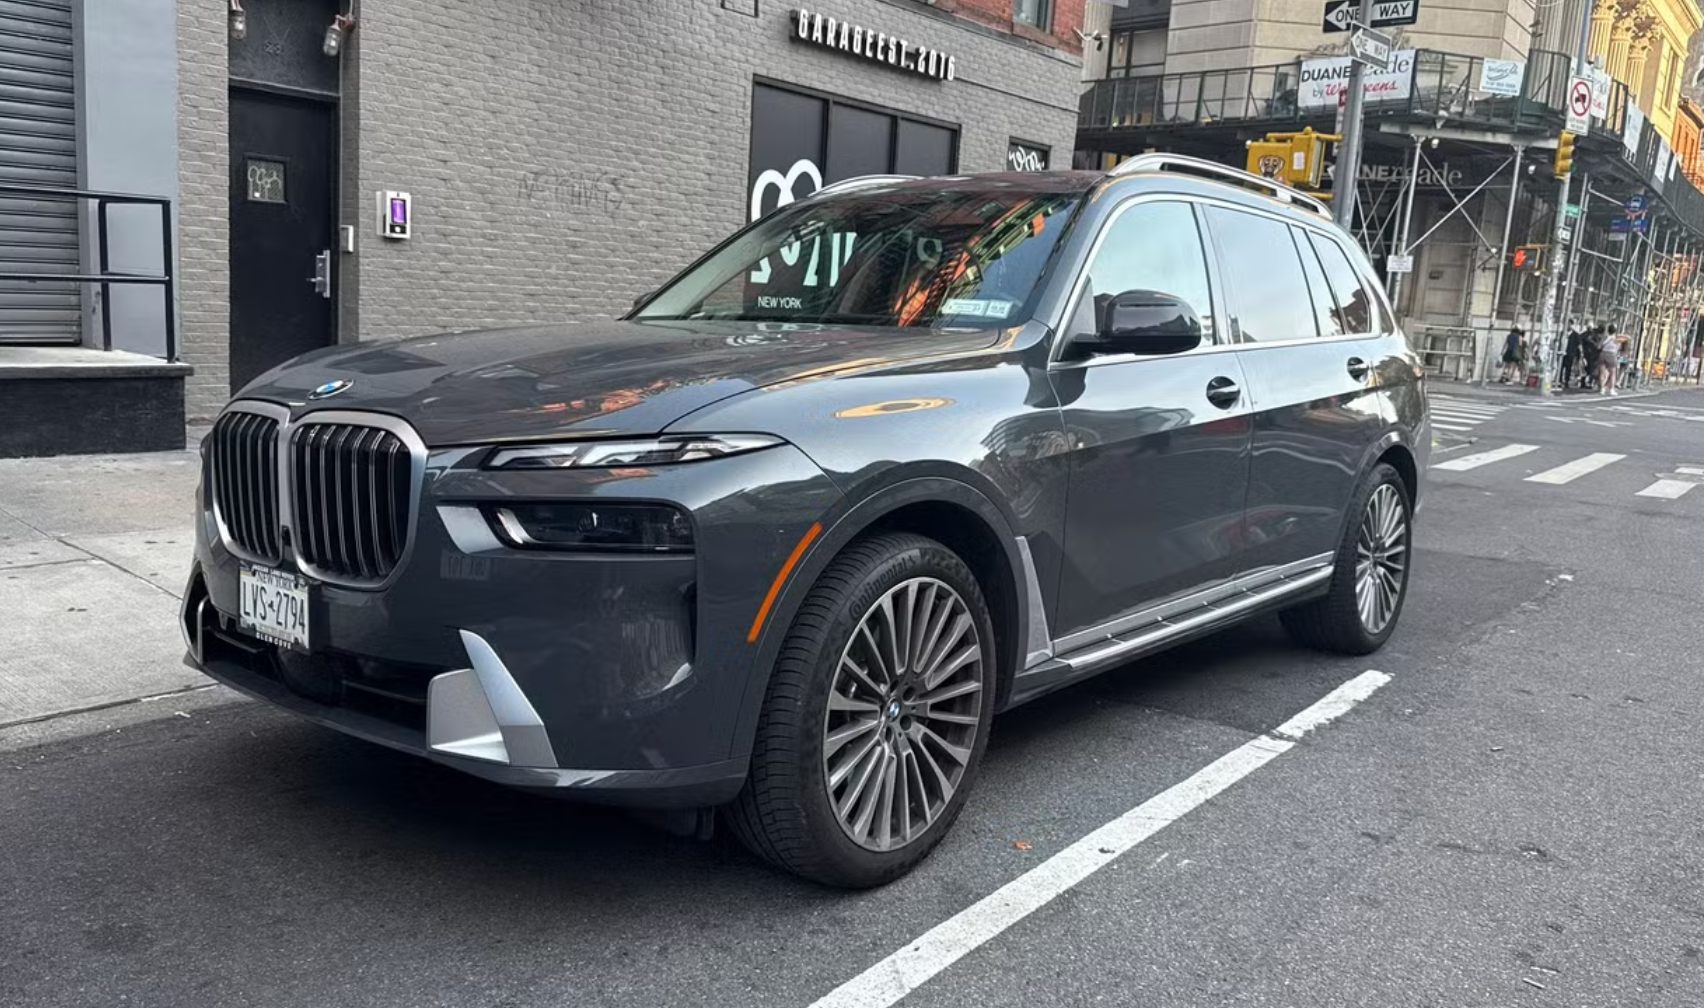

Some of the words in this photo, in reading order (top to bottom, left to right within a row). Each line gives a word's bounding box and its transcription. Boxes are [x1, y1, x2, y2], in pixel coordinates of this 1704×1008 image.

[1335, 8, 1360, 22] ONE
[1379, 2, 1411, 18] WAY
[757, 295, 778, 309] NEW
[779, 296, 803, 309] YORK
[848, 557, 908, 621] Continental
